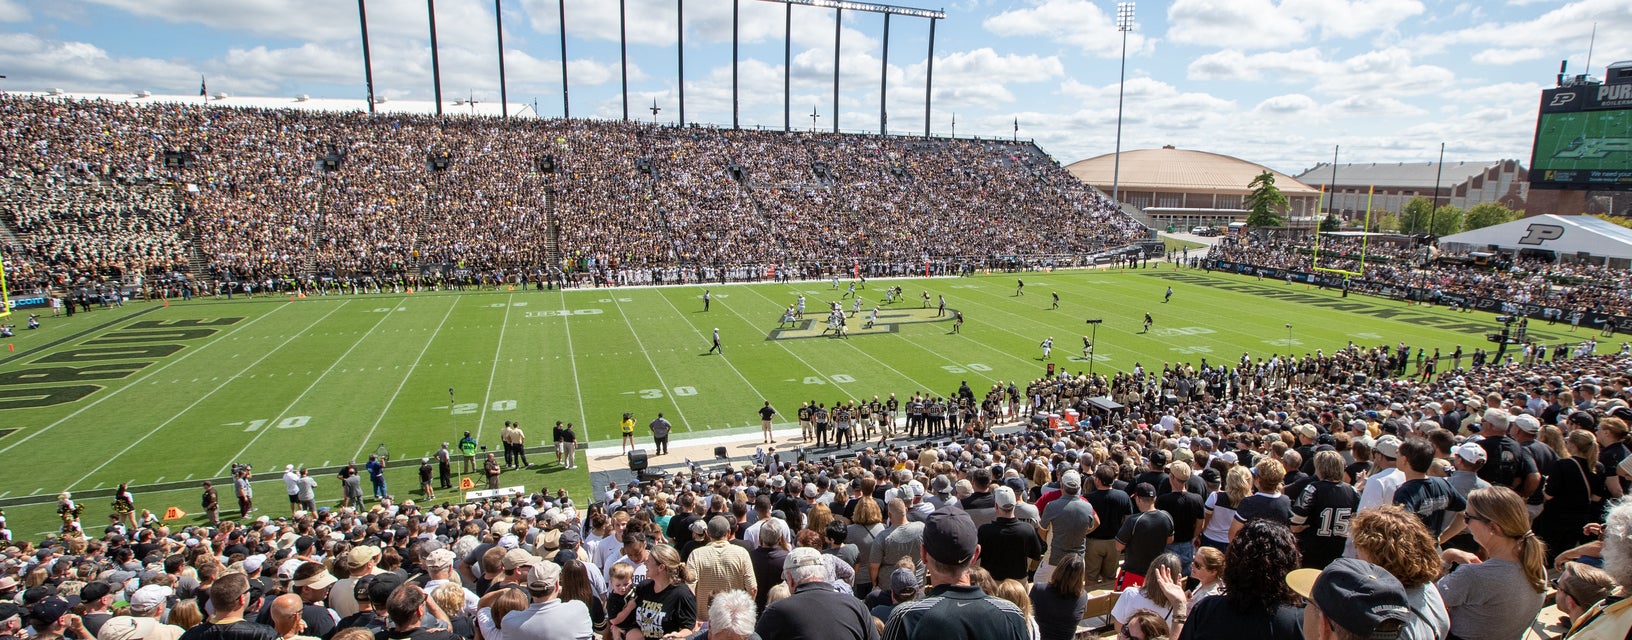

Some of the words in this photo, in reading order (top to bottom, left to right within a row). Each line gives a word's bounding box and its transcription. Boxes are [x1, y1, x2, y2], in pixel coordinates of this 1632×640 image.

[1597, 85, 1632, 101] PUR
[168, 511, 176, 520] 10
[1317, 507, 1351, 537] 15
